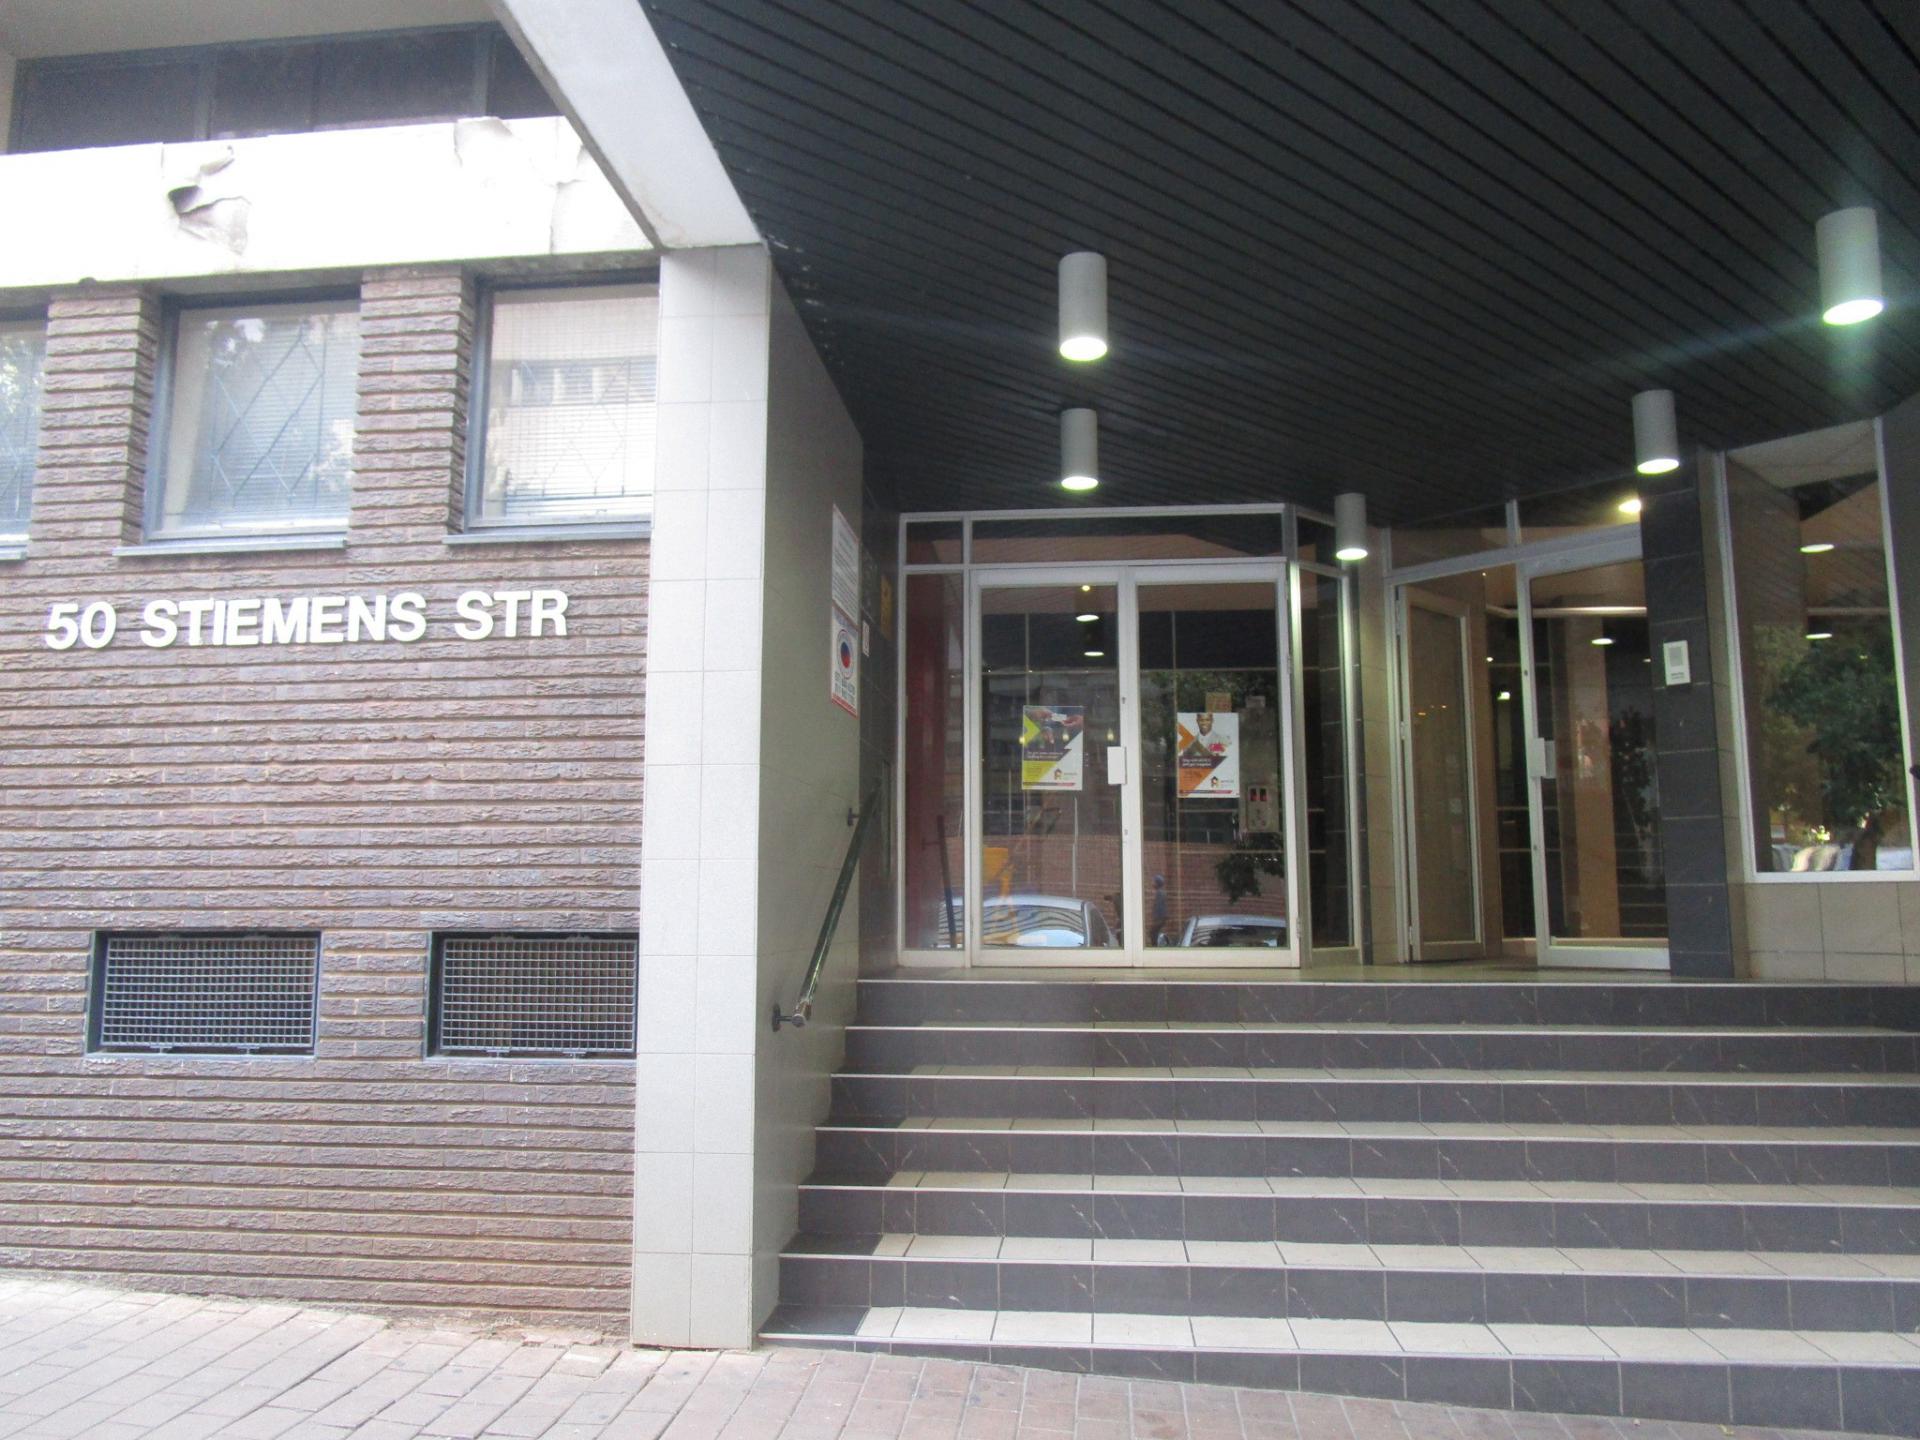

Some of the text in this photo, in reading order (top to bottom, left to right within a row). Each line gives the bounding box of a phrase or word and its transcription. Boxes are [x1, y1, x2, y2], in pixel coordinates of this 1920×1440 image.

[44, 589, 569, 649] 50 STIEMENS STR
